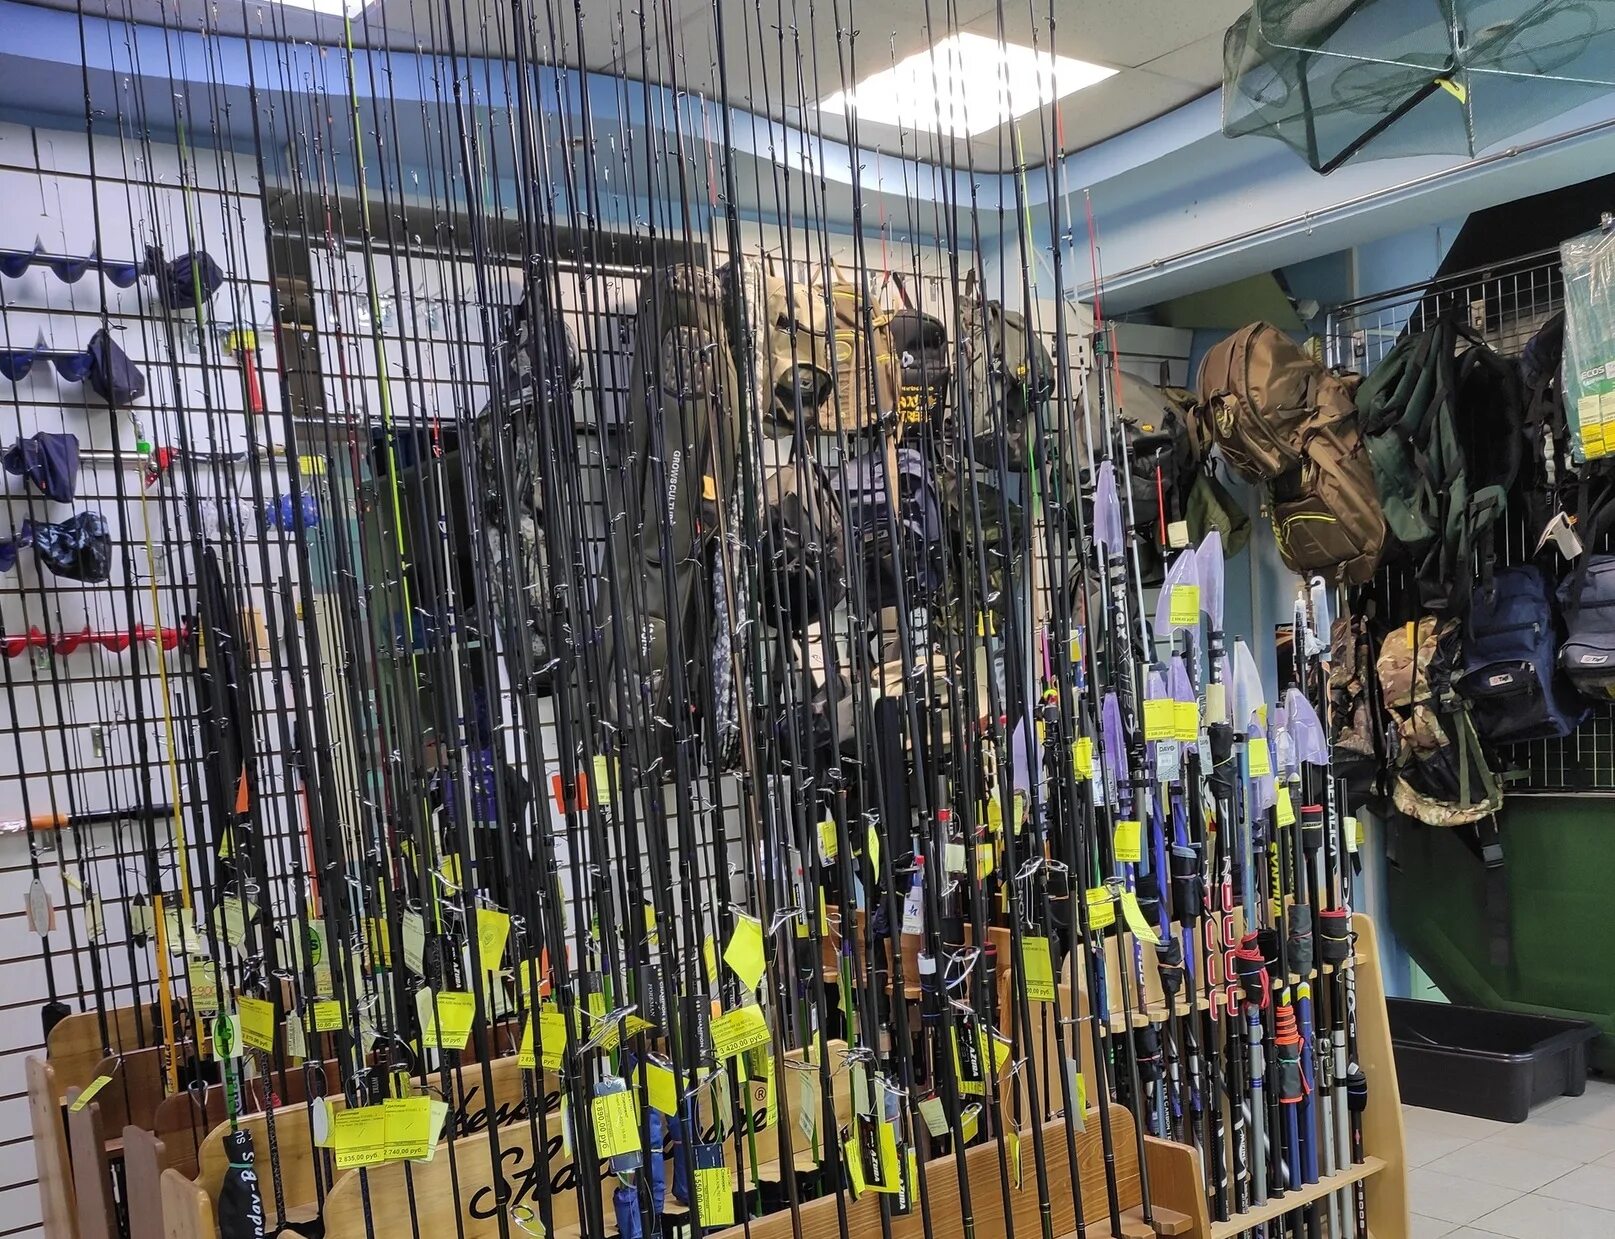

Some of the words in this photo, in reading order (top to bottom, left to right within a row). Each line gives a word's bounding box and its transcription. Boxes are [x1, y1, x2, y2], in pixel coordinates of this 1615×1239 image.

[659, 981, 667, 1017] CHAMPION
[726, 1039, 748, 1051] 420,00
[344, 1154, 364, 1162] 835,00
